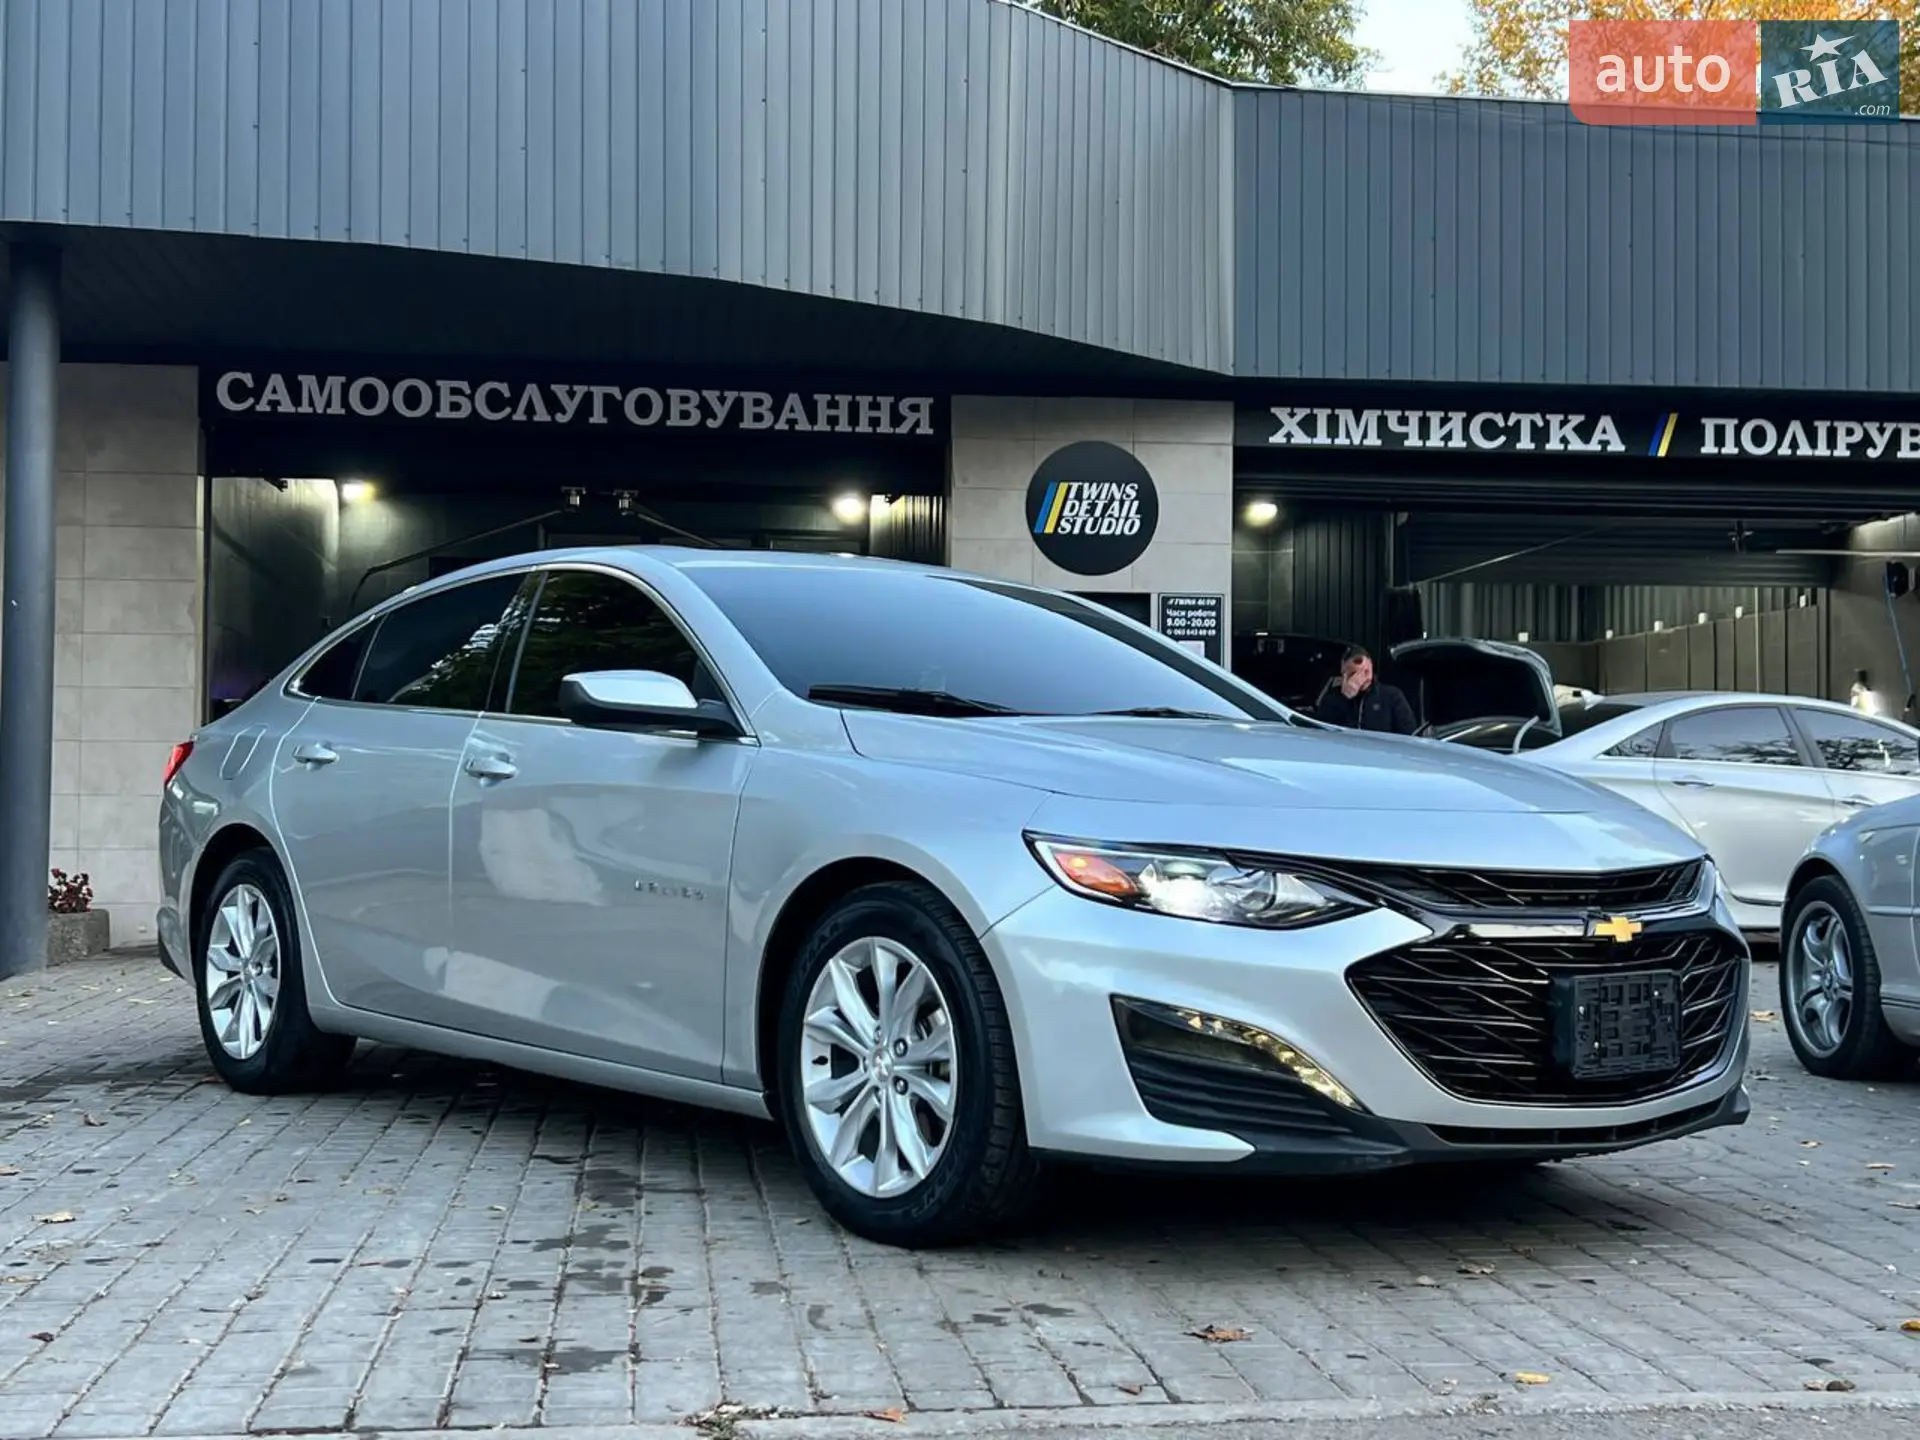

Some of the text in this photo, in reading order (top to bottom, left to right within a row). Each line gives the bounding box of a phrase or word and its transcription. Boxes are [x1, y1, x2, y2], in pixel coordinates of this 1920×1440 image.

[216, 371, 934, 435] САМООБСЛУГОВУВАННЯ
[1268, 406, 1626, 452] ХІМЧИСТКА
[1067, 482, 1139, 501] TWINS
[1062, 500, 1143, 518] DETAIL
[1057, 517, 1141, 535] STUDIO
[1166, 608, 1216, 619] Часи роботи
